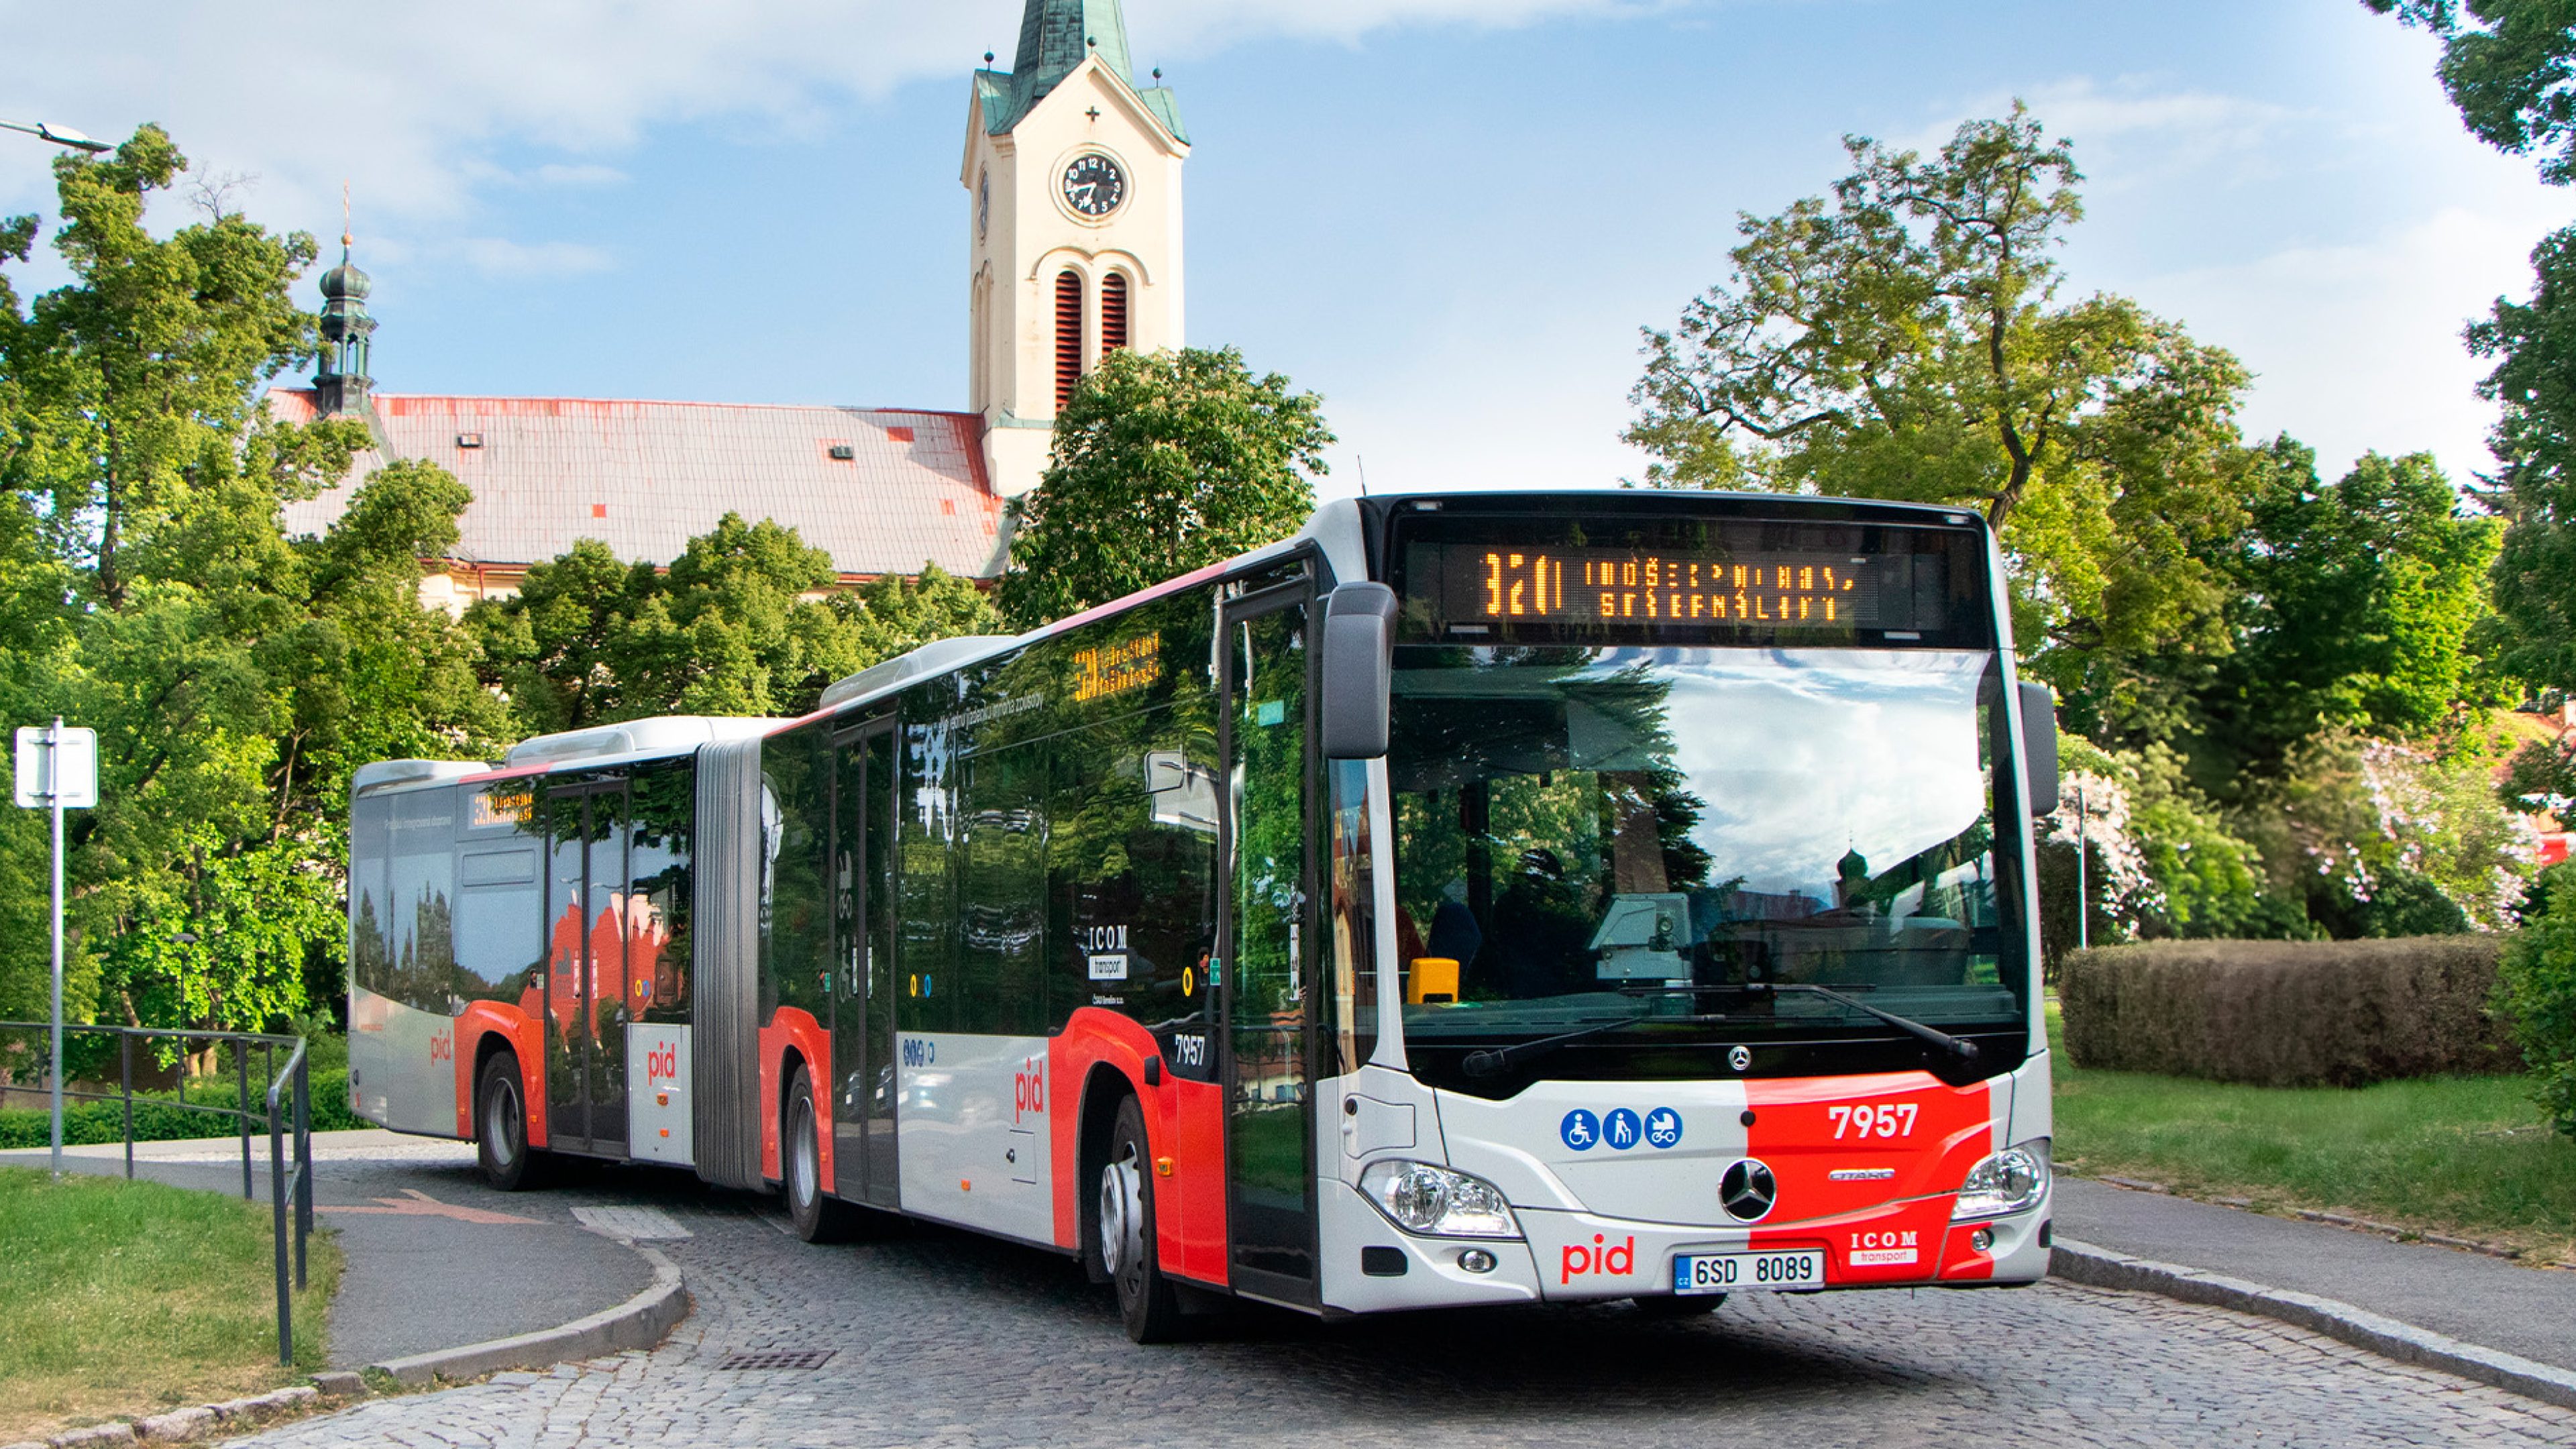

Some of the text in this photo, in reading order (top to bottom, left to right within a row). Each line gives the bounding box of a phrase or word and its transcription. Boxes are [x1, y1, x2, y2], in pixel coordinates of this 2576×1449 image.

[1078, 160, 1085, 171] 11
[1088, 158, 1097, 168] 12
[1069, 168, 1078, 178] 10
[1109, 168, 1116, 179] 2
[1114, 182, 1120, 192] 3
[1090, 203, 1096, 213] 6
[1102, 201, 1107, 211] 5
[1089, 924, 1128, 951] ICOM
[431, 1028, 451, 1067] pid
[1175, 1034, 1205, 1066] 7957
[648, 1042, 676, 1086] pid
[1016, 1057, 1043, 1124] pid
[1829, 1104, 1918, 1139] 7957
[1851, 1230, 1917, 1248] ICOM
[1562, 1234, 1634, 1284] pid
[1861, 1250, 1907, 1263] transport
[1696, 1258, 1737, 1285] 6SD
[1756, 1255, 1812, 1282] 8089
